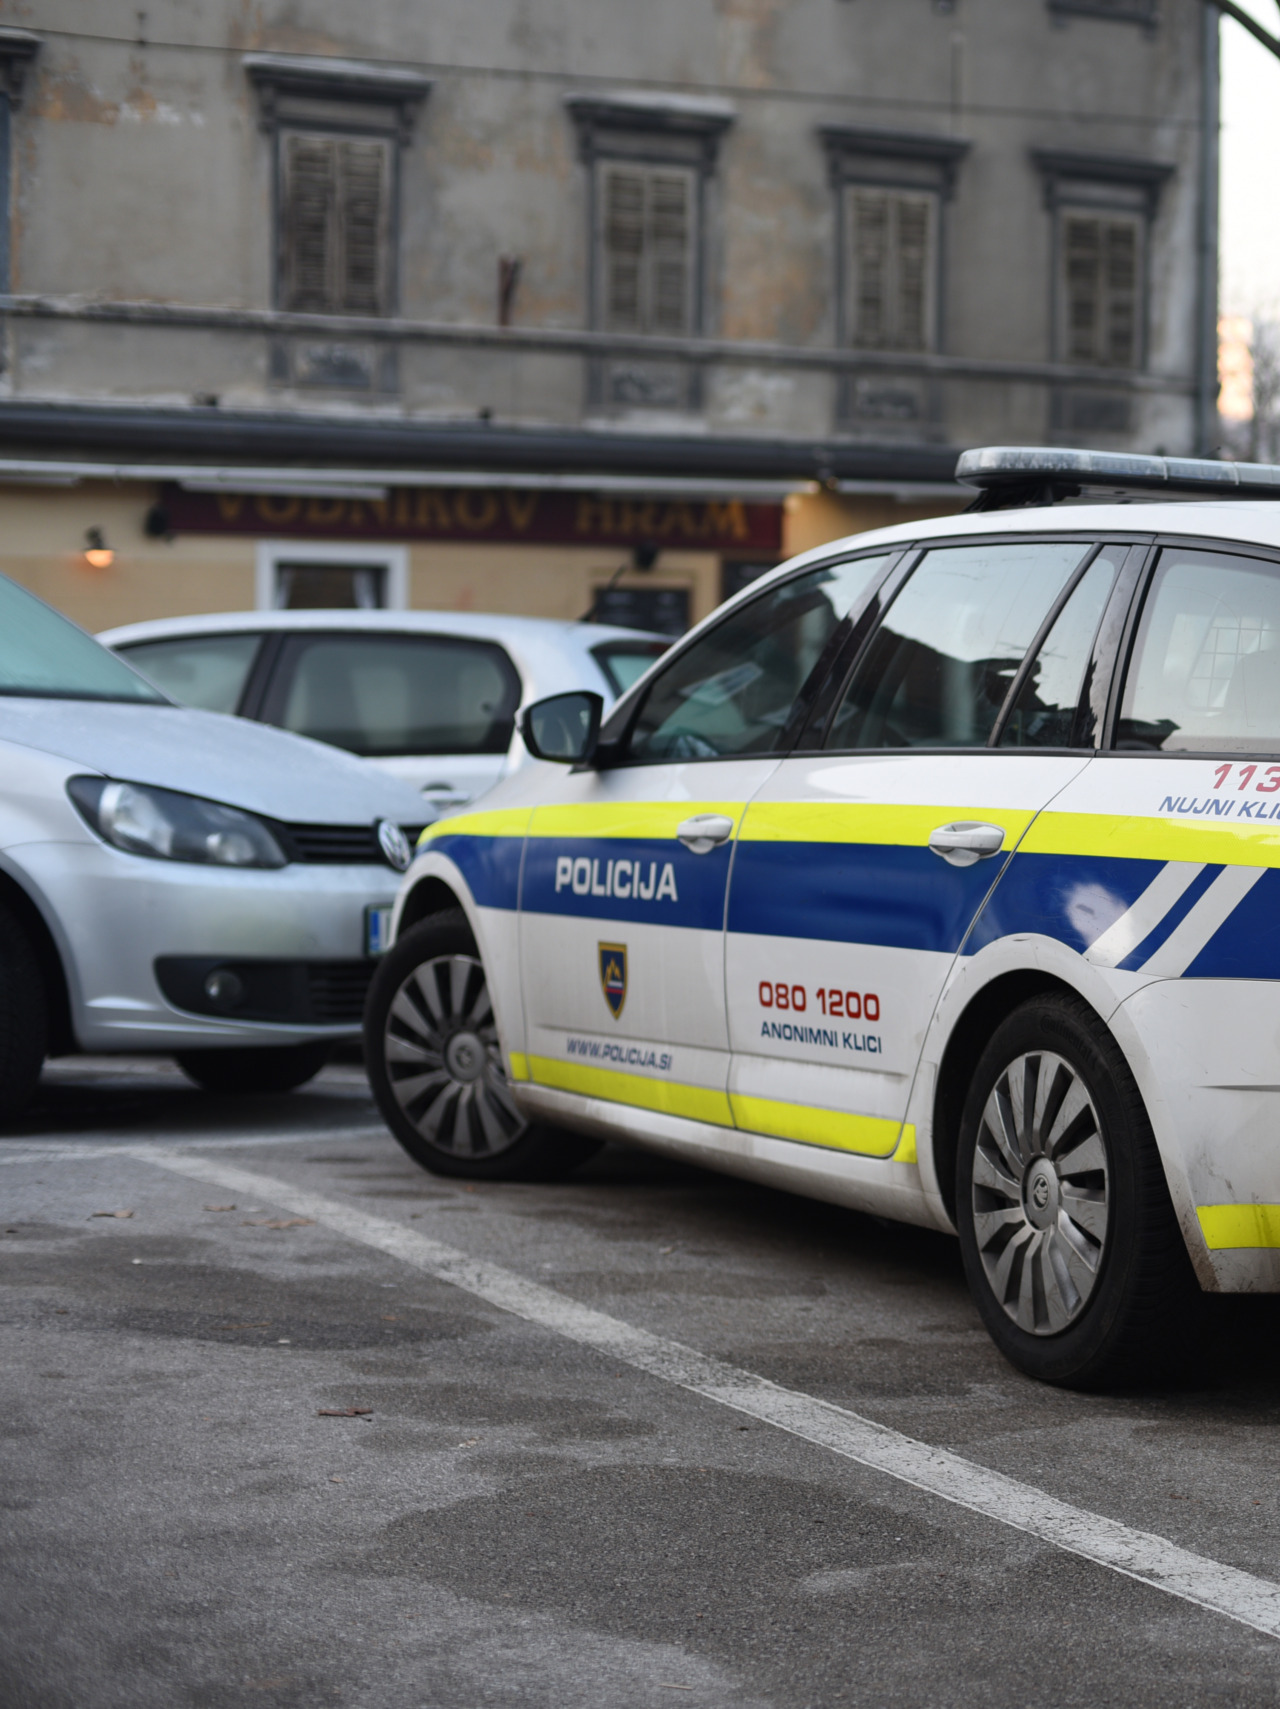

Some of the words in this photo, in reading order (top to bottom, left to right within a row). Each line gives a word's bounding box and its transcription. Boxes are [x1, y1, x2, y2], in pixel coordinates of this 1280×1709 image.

[1158, 796, 1236, 816] NUJNI
[555, 856, 678, 902] POLICIJA
[759, 981, 807, 1013] 080
[815, 988, 881, 1021] 1200
[567, 1037, 673, 1072] WWW.POLICIJA.SI
[761, 1021, 838, 1049] ANONIMNI
[842, 1032, 883, 1054] KLICI
